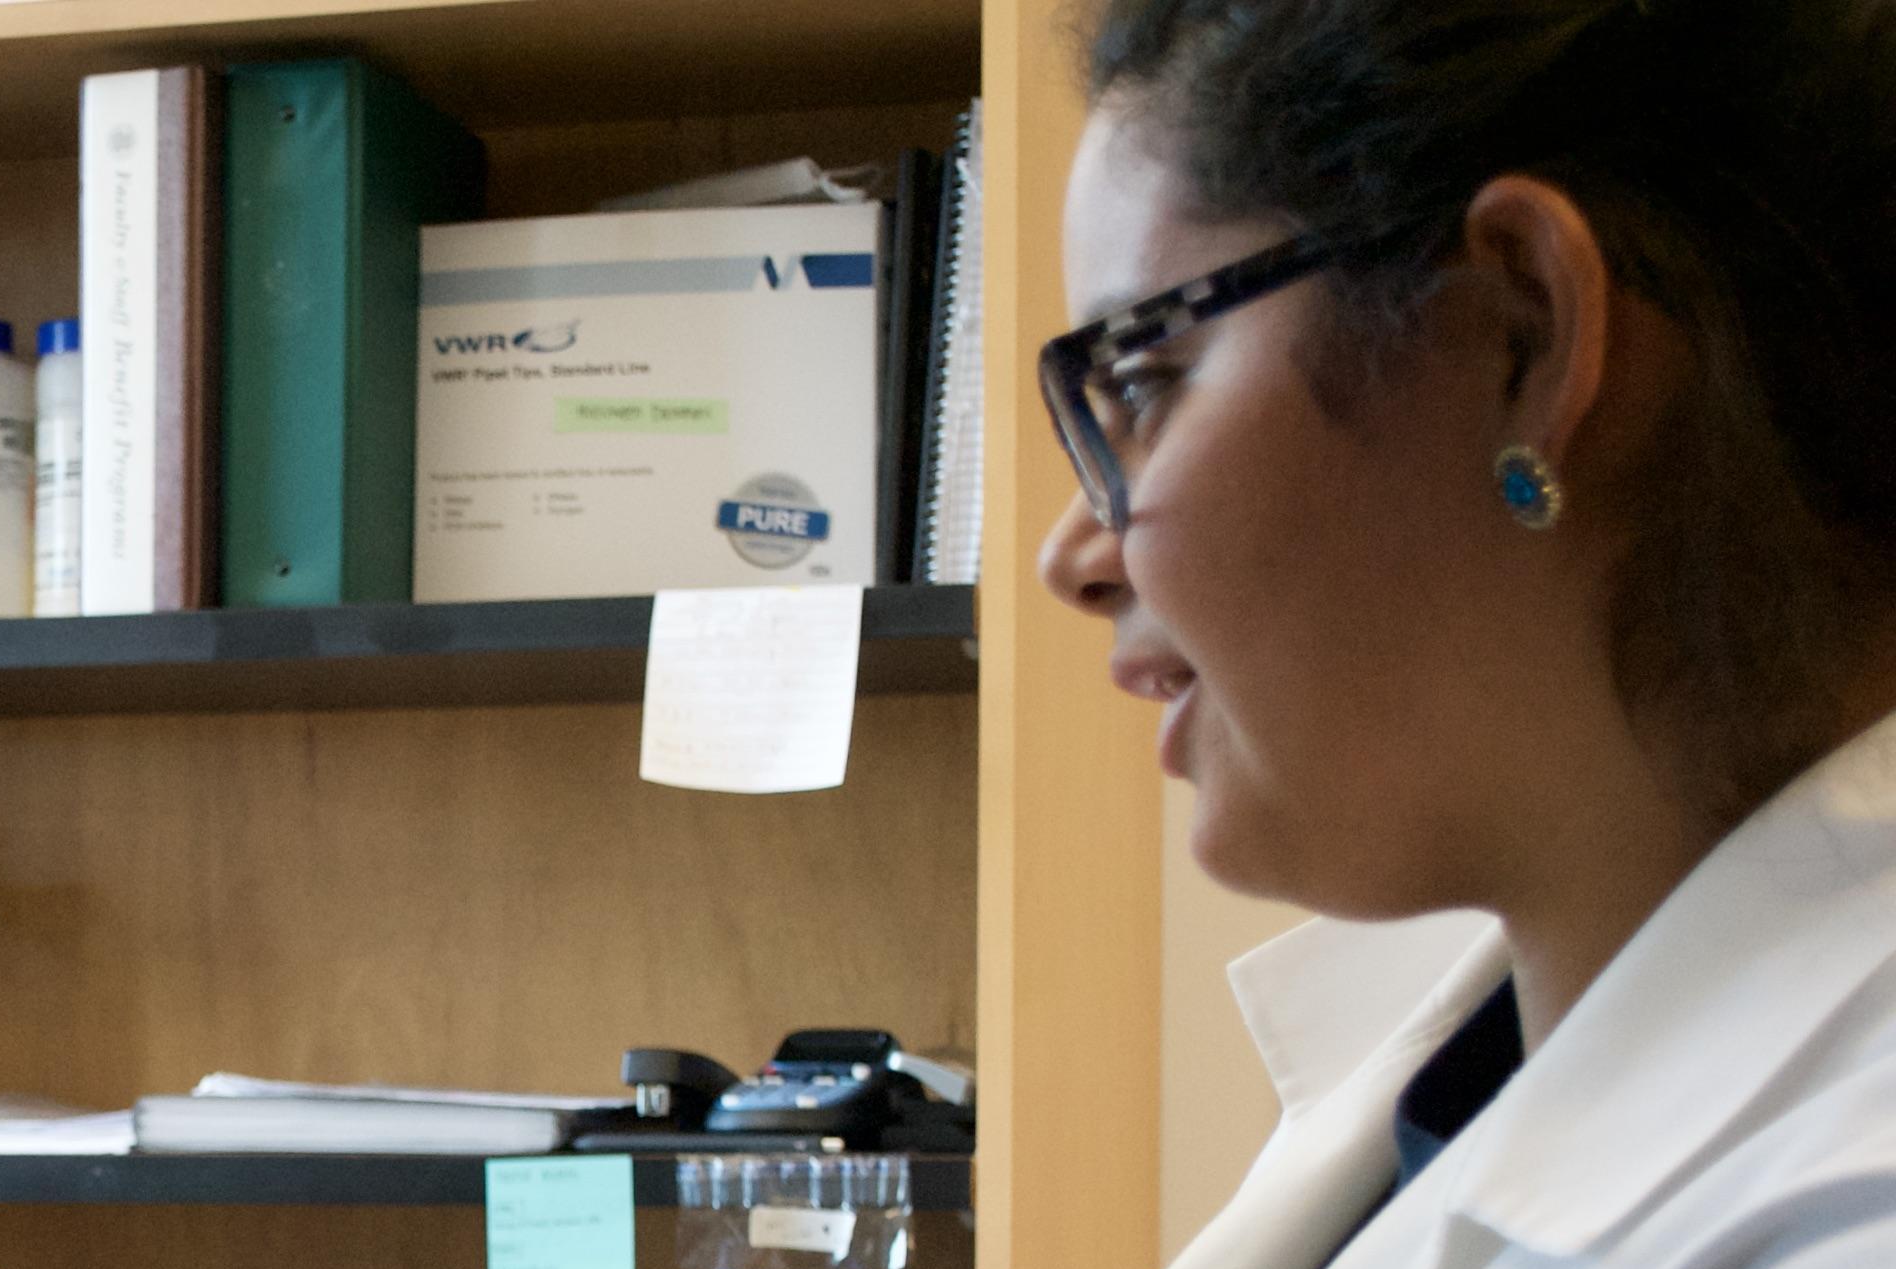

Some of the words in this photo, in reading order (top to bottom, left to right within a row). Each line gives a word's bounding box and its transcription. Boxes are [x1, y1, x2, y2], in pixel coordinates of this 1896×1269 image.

[434, 333, 506, 354] VWR
[110, 338, 136, 429] Benefit
[737, 505, 808, 536] PURE
